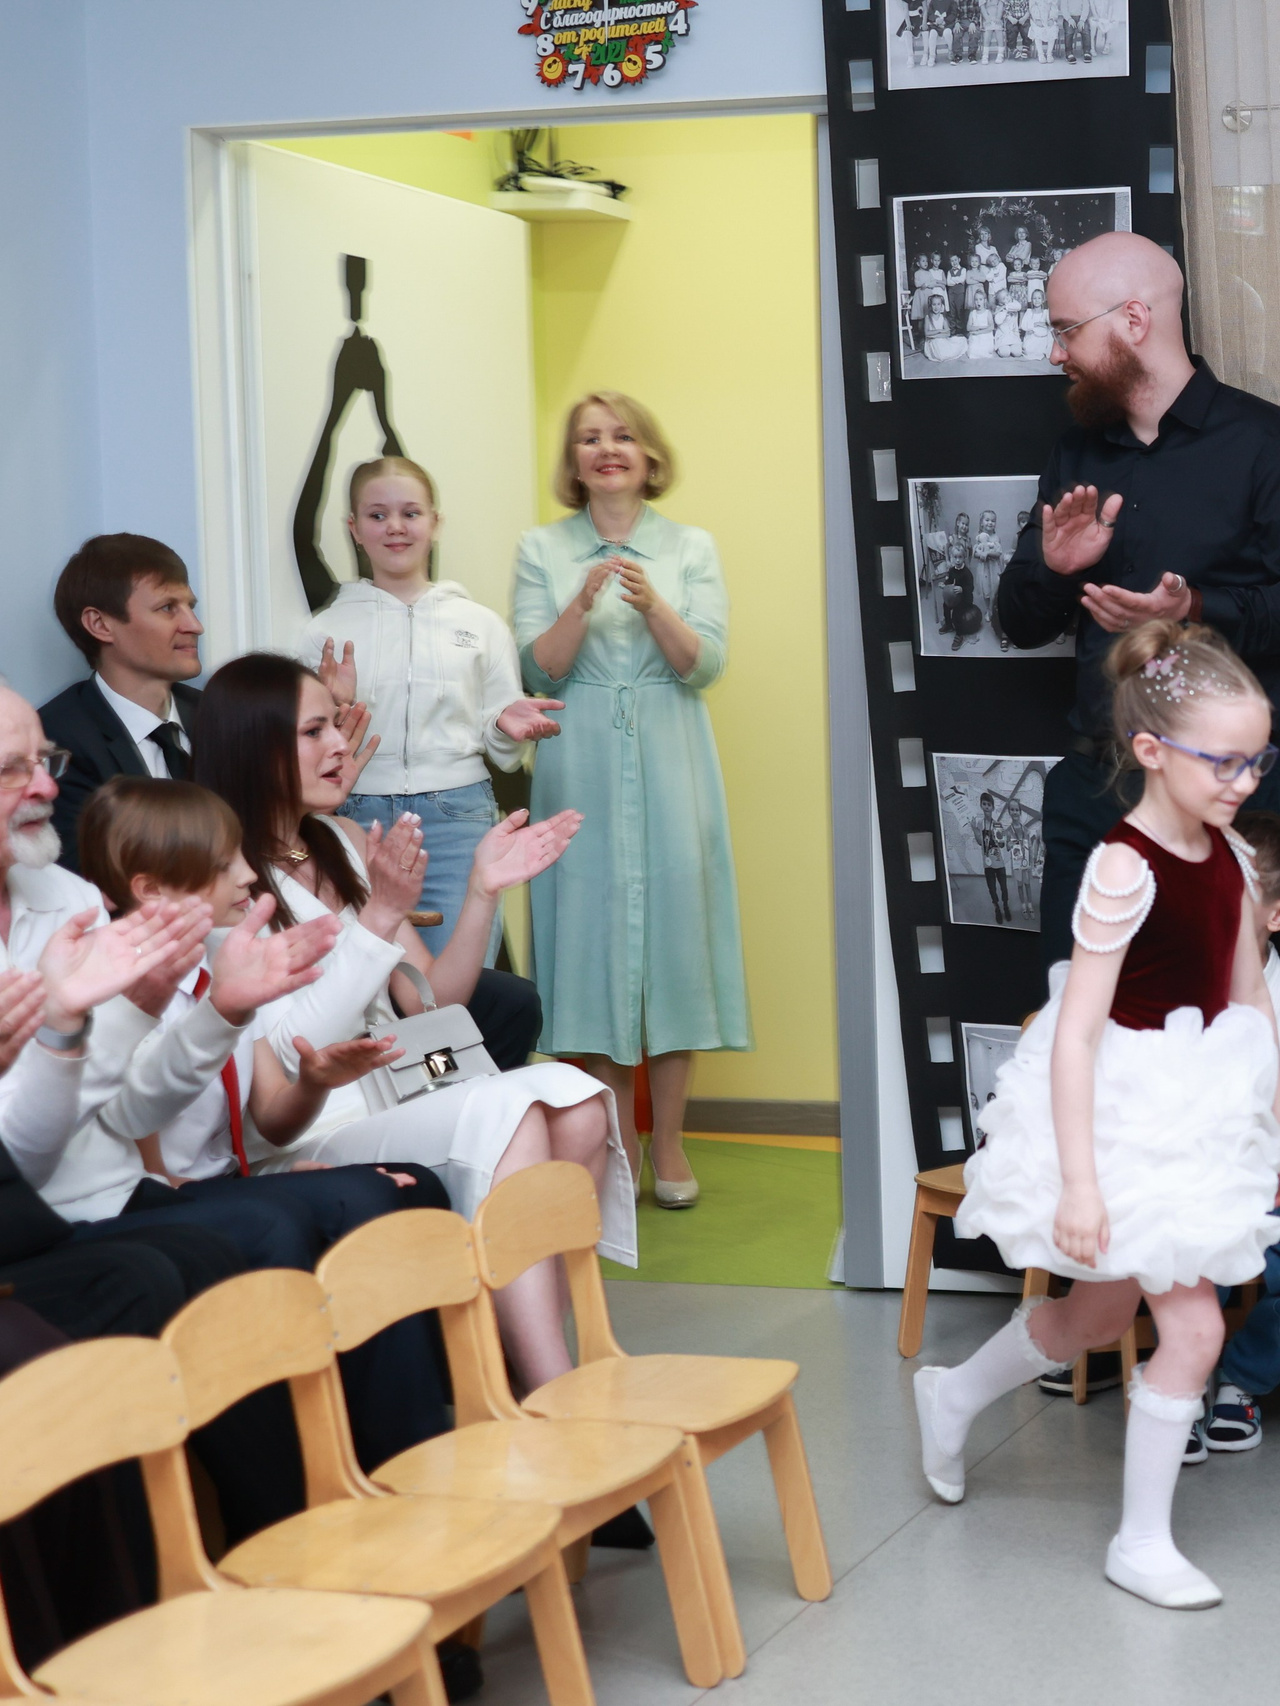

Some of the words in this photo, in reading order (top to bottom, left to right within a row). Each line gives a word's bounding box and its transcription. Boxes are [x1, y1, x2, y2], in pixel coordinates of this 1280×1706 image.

[554, 31, 578, 44] от
[580, 17, 667, 44] родителей
[669, 9, 687, 34] 4
[536, 34, 554, 56] 8
[646, 45, 663, 69] 5
[568, 63, 585, 88] 7
[603, 64, 621, 86] 6
